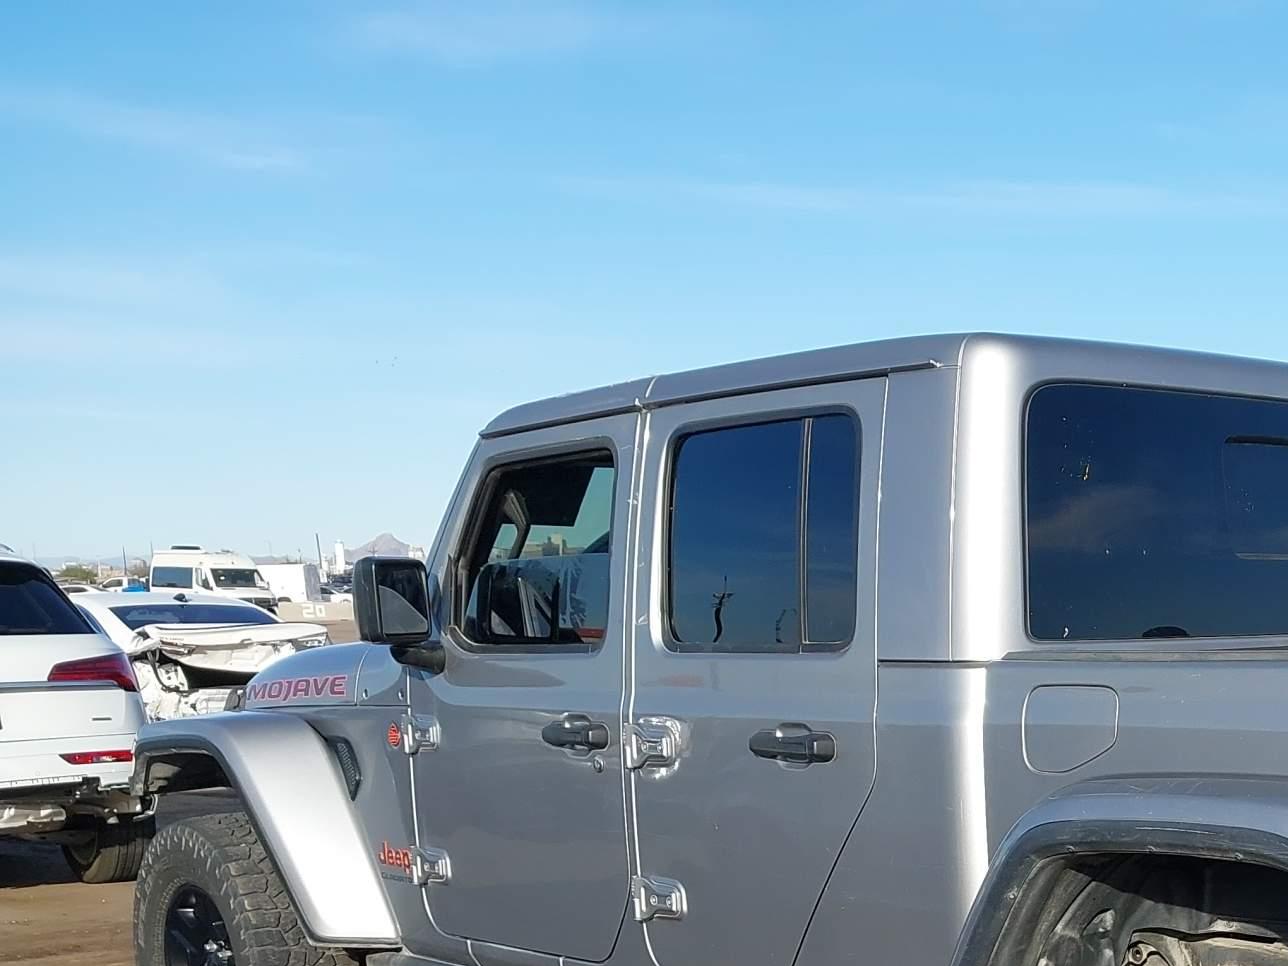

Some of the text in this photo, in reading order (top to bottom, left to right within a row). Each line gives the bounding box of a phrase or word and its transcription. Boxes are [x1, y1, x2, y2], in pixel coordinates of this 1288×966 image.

[302, 603, 326, 618] 20
[246, 674, 348, 702] MOJAVE
[379, 840, 412, 874] Jeep
